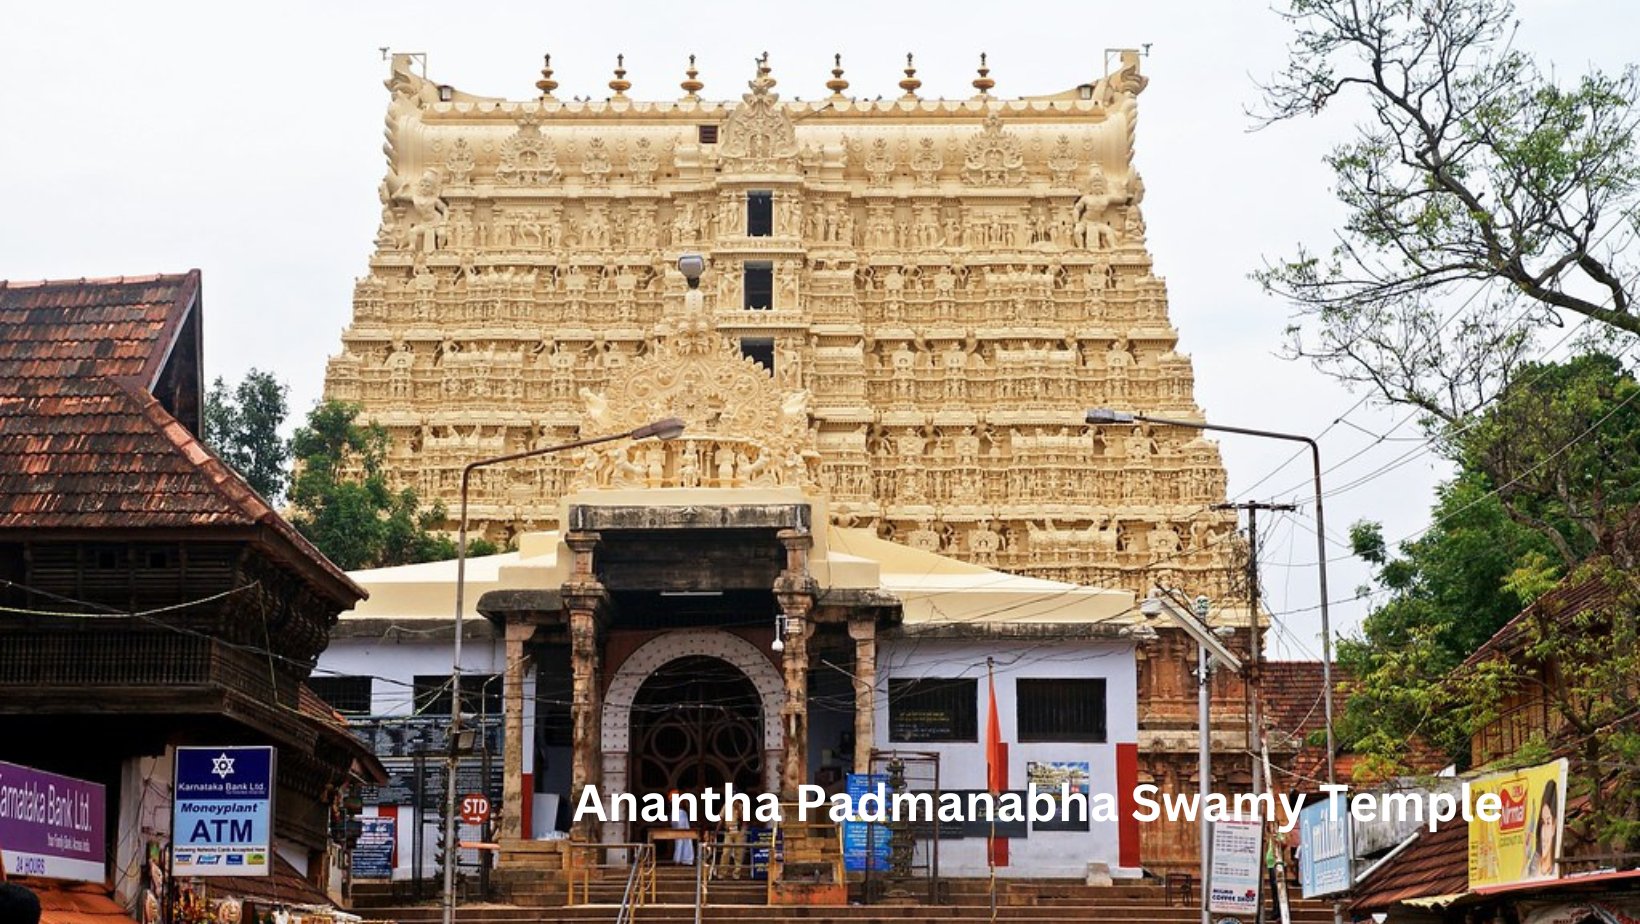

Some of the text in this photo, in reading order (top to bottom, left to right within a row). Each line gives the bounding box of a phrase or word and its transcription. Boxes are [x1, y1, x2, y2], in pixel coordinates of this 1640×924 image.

[178, 782, 223, 792] Karnataka
[225, 782, 247, 791] Bank
[0, 773, 92, 832] arnataka Bank Ltd.
[181, 803, 258, 815] Moneyplant
[463, 798, 488, 815] STD
[190, 819, 253, 843] ATM
[16, 856, 45, 874] 24 HOURS
